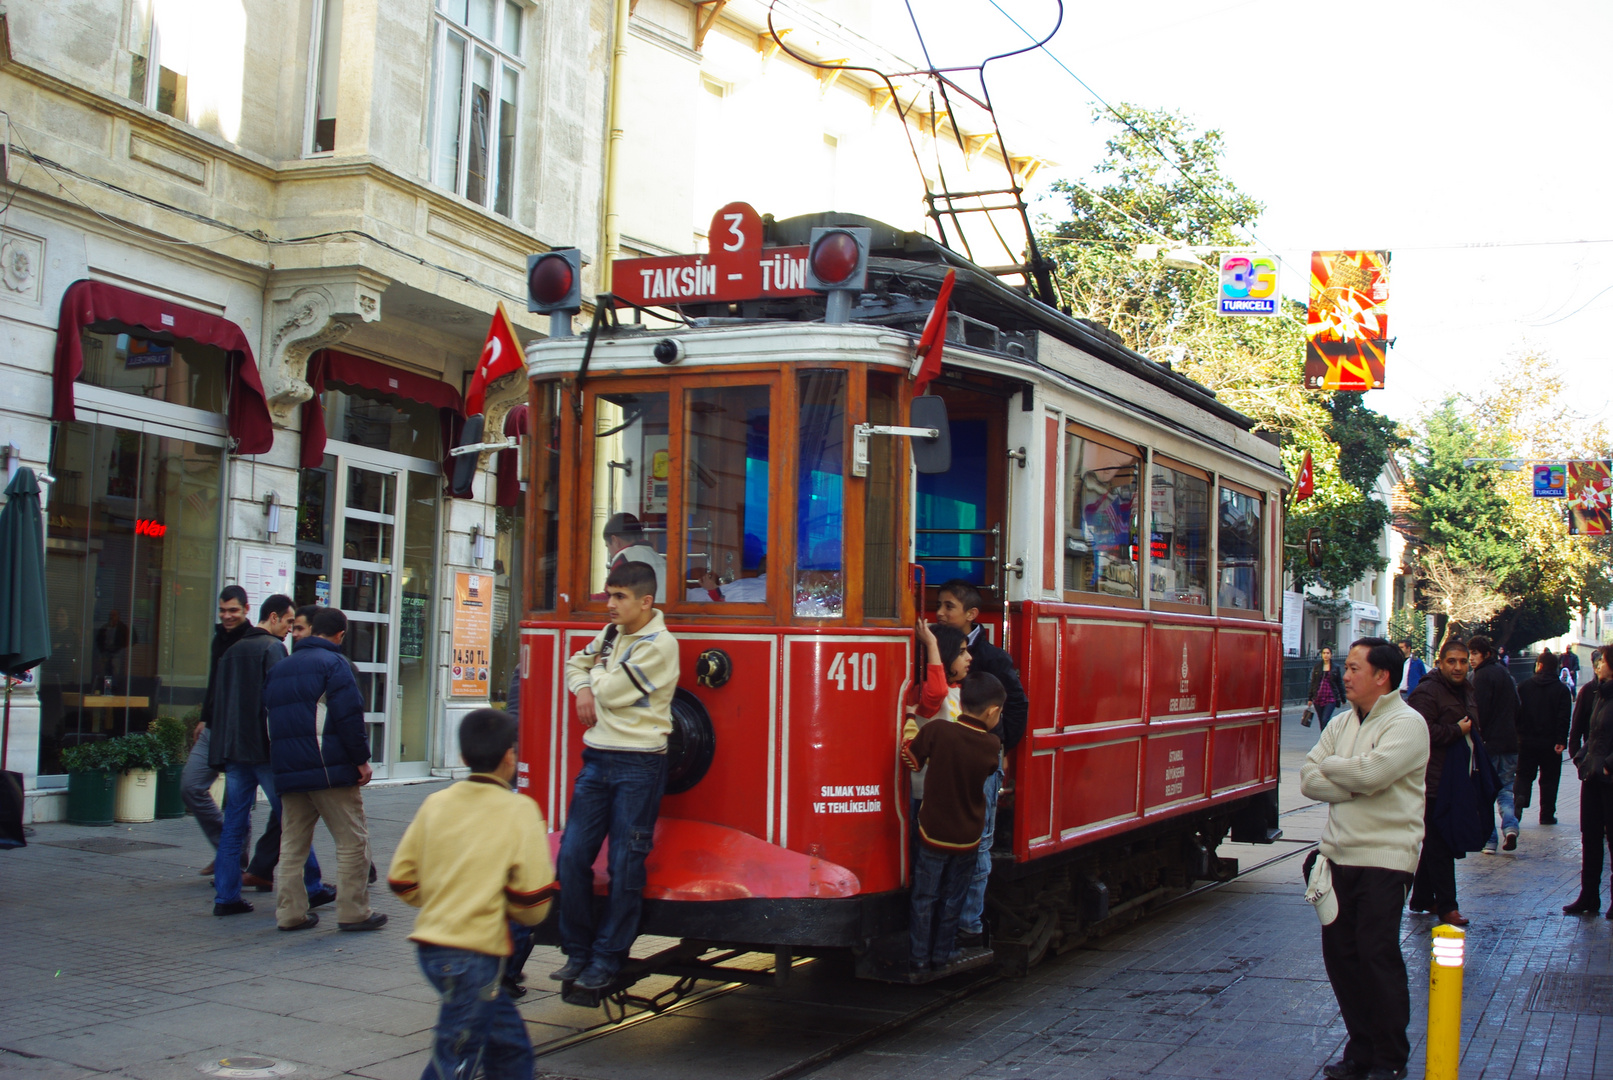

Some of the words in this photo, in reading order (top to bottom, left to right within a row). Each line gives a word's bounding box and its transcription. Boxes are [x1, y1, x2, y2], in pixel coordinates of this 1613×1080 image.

[723, 213, 745, 252] 3
[640, 260, 716, 299] TAKSİM
[1223, 257, 1276, 298] 3G
[1223, 300, 1273, 310] TURKCELL
[1534, 466, 1565, 489] 3G
[827, 652, 877, 691] 410
[1169, 749, 1183, 762] İSTANBUL
[855, 785, 880, 796] YASAK
[813, 802, 826, 813] VE
[827, 798, 882, 813] TEHLİKELİDİR
